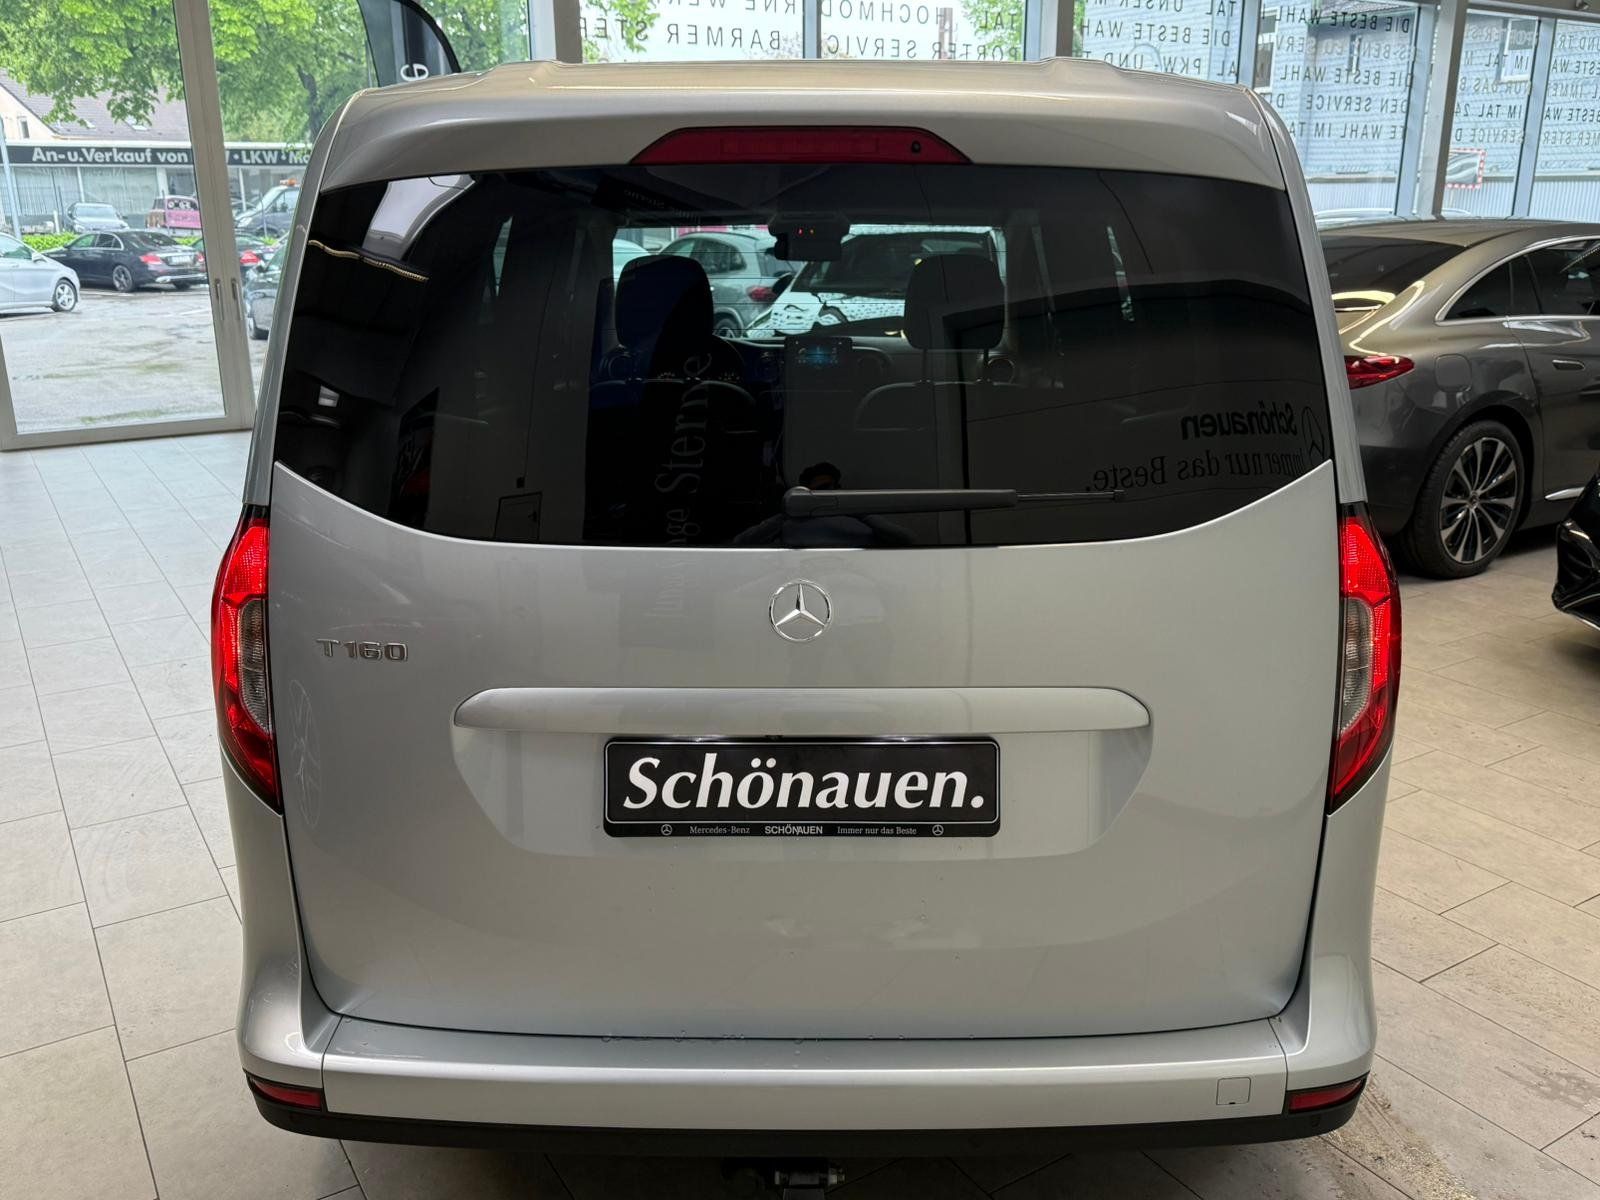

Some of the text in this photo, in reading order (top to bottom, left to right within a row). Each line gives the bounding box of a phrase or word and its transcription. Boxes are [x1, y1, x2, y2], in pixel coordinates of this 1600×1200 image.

[157, 150, 188, 164] von
[241, 150, 279, 164] LKW
[623, 752, 985, 810] Schönauen.
[689, 825, 750, 835] Mercedes-Benz
[764, 823, 823, 835] SCHÖNAUEN
[837, 825, 862, 835] Immer
[880, 825, 893, 835] das
[895, 825, 917, 836] Beste
